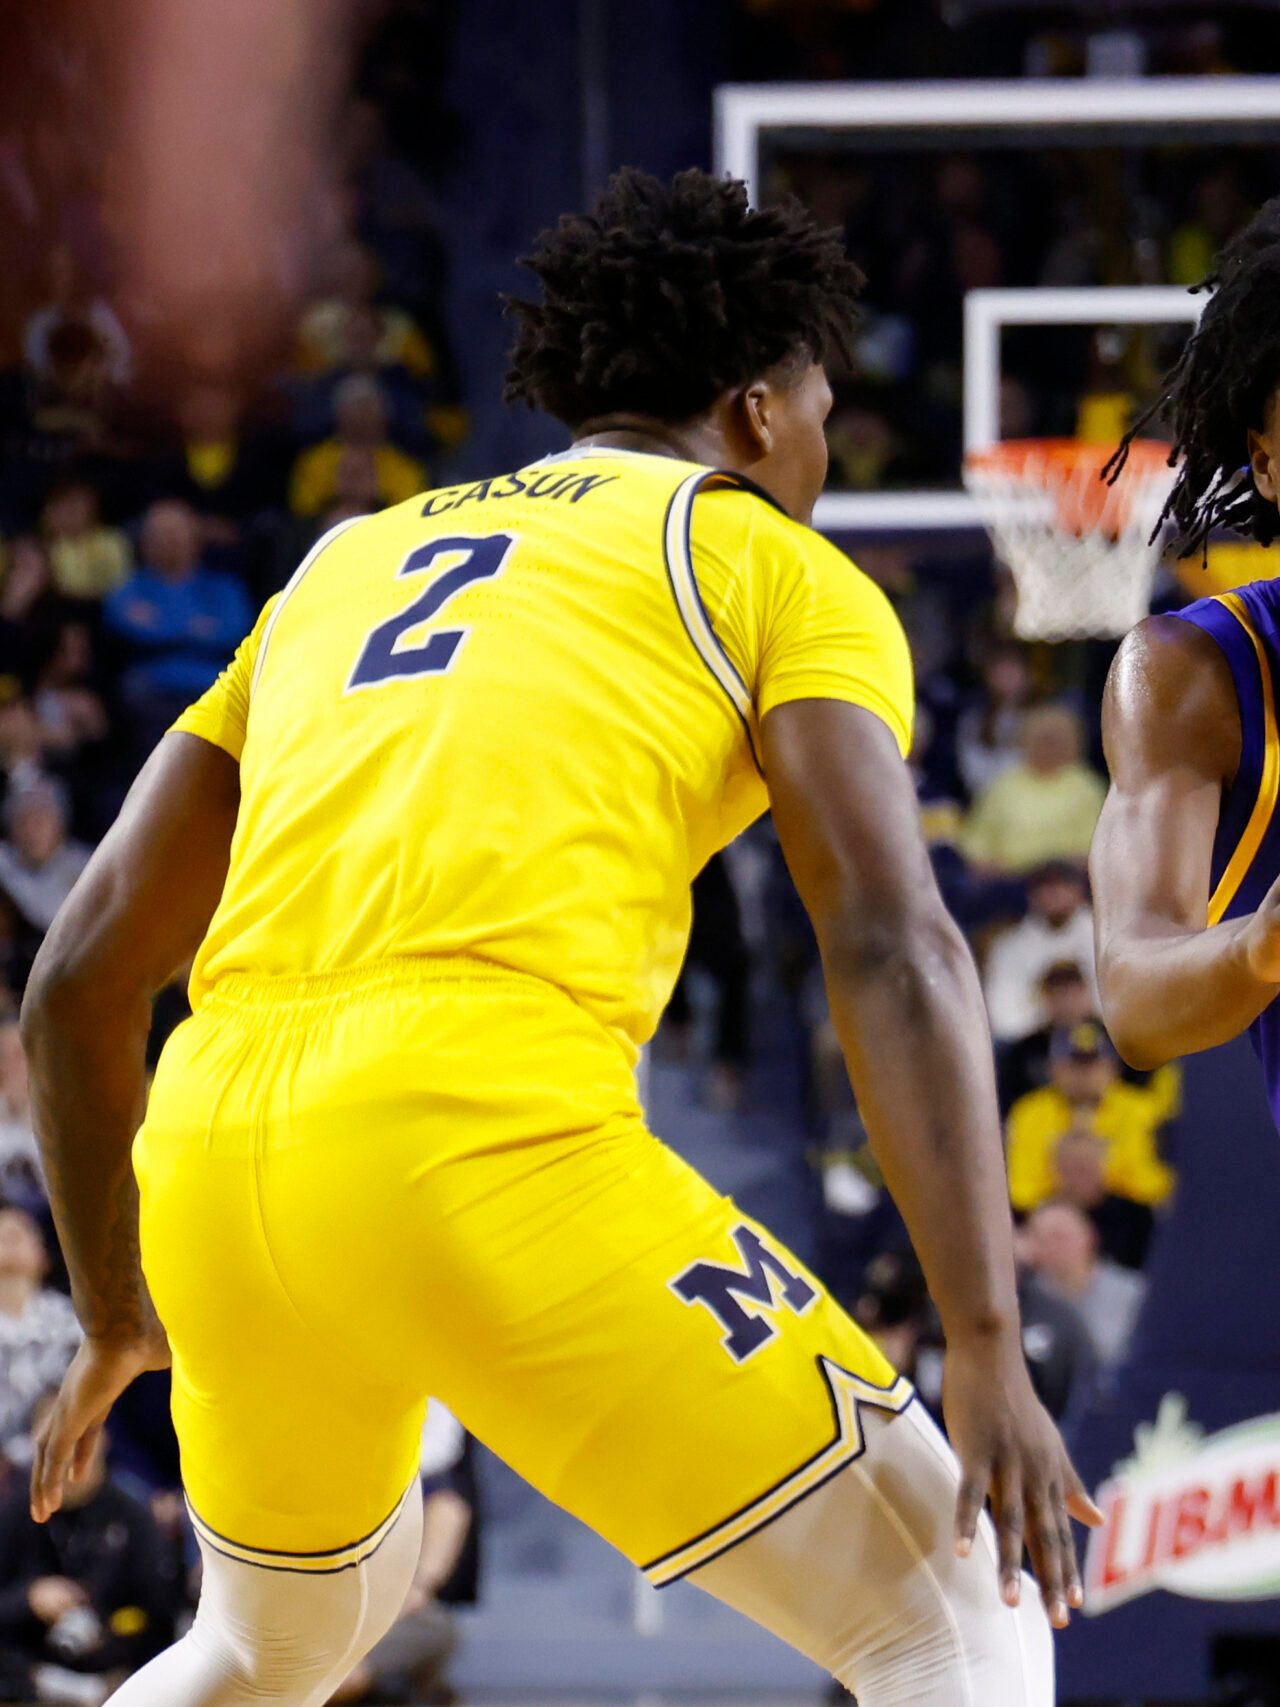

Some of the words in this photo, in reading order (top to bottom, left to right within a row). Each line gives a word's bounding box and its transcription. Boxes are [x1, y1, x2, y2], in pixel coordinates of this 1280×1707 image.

[421, 471, 621, 517] CASON
[344, 532, 518, 694] 2
[667, 1223, 820, 1364] M
